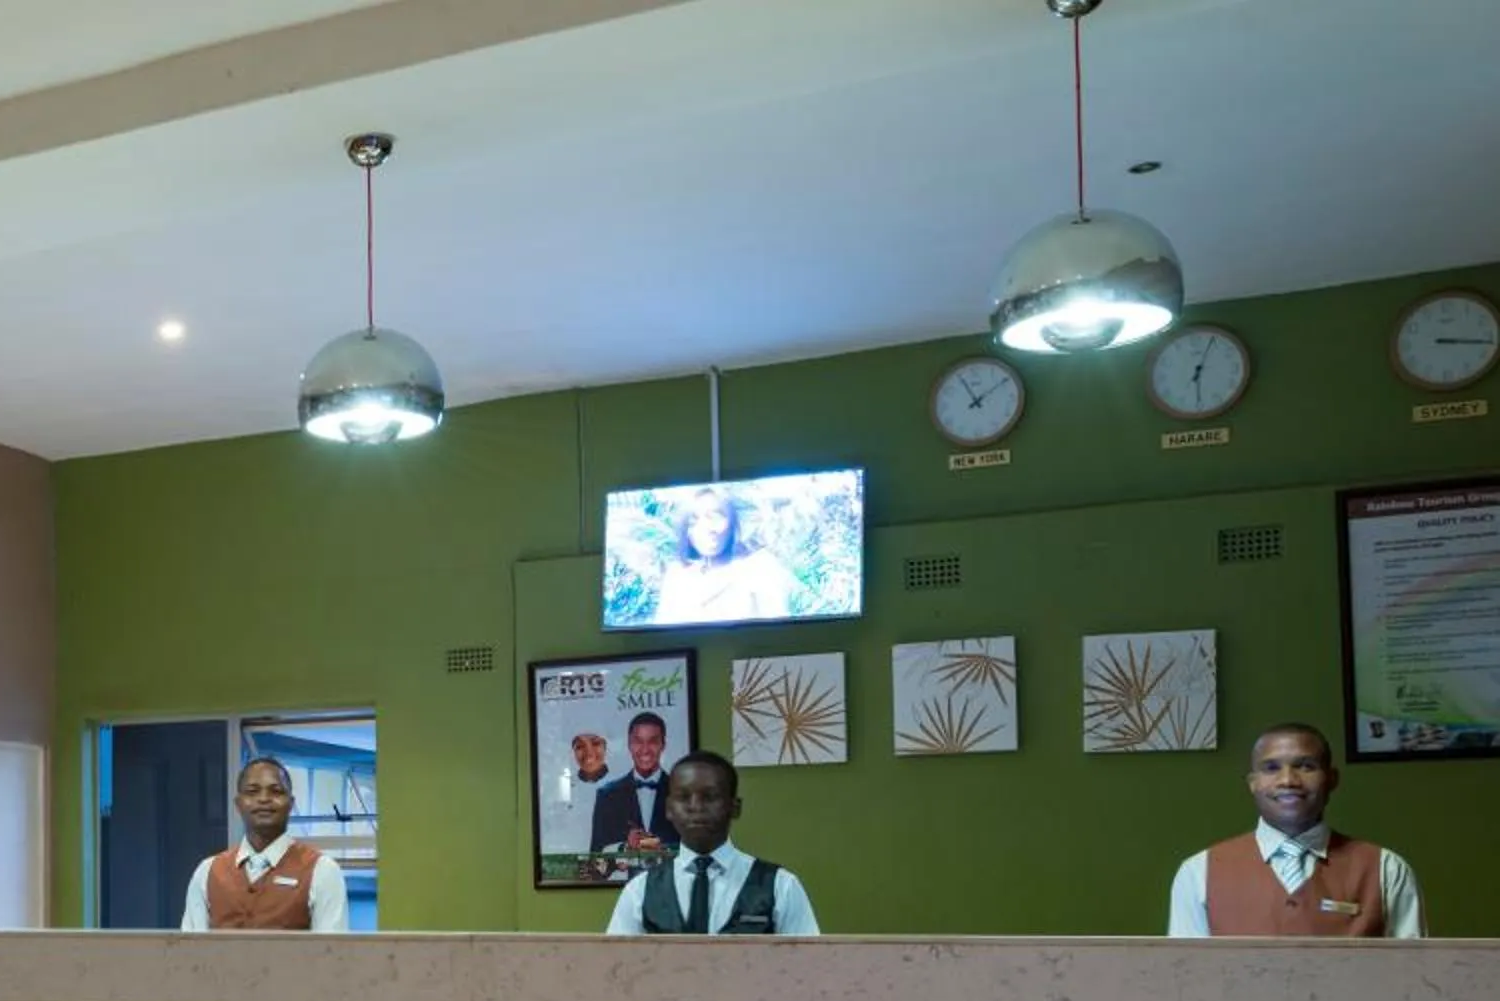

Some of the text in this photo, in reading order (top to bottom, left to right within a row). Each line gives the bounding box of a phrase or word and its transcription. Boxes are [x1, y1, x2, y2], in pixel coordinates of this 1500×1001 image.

[1420, 402, 1479, 419] SYDNEY
[1169, 431, 1222, 445] HARARE
[954, 452, 1006, 467] NEW YORK
[617, 690, 677, 710] SMILE
